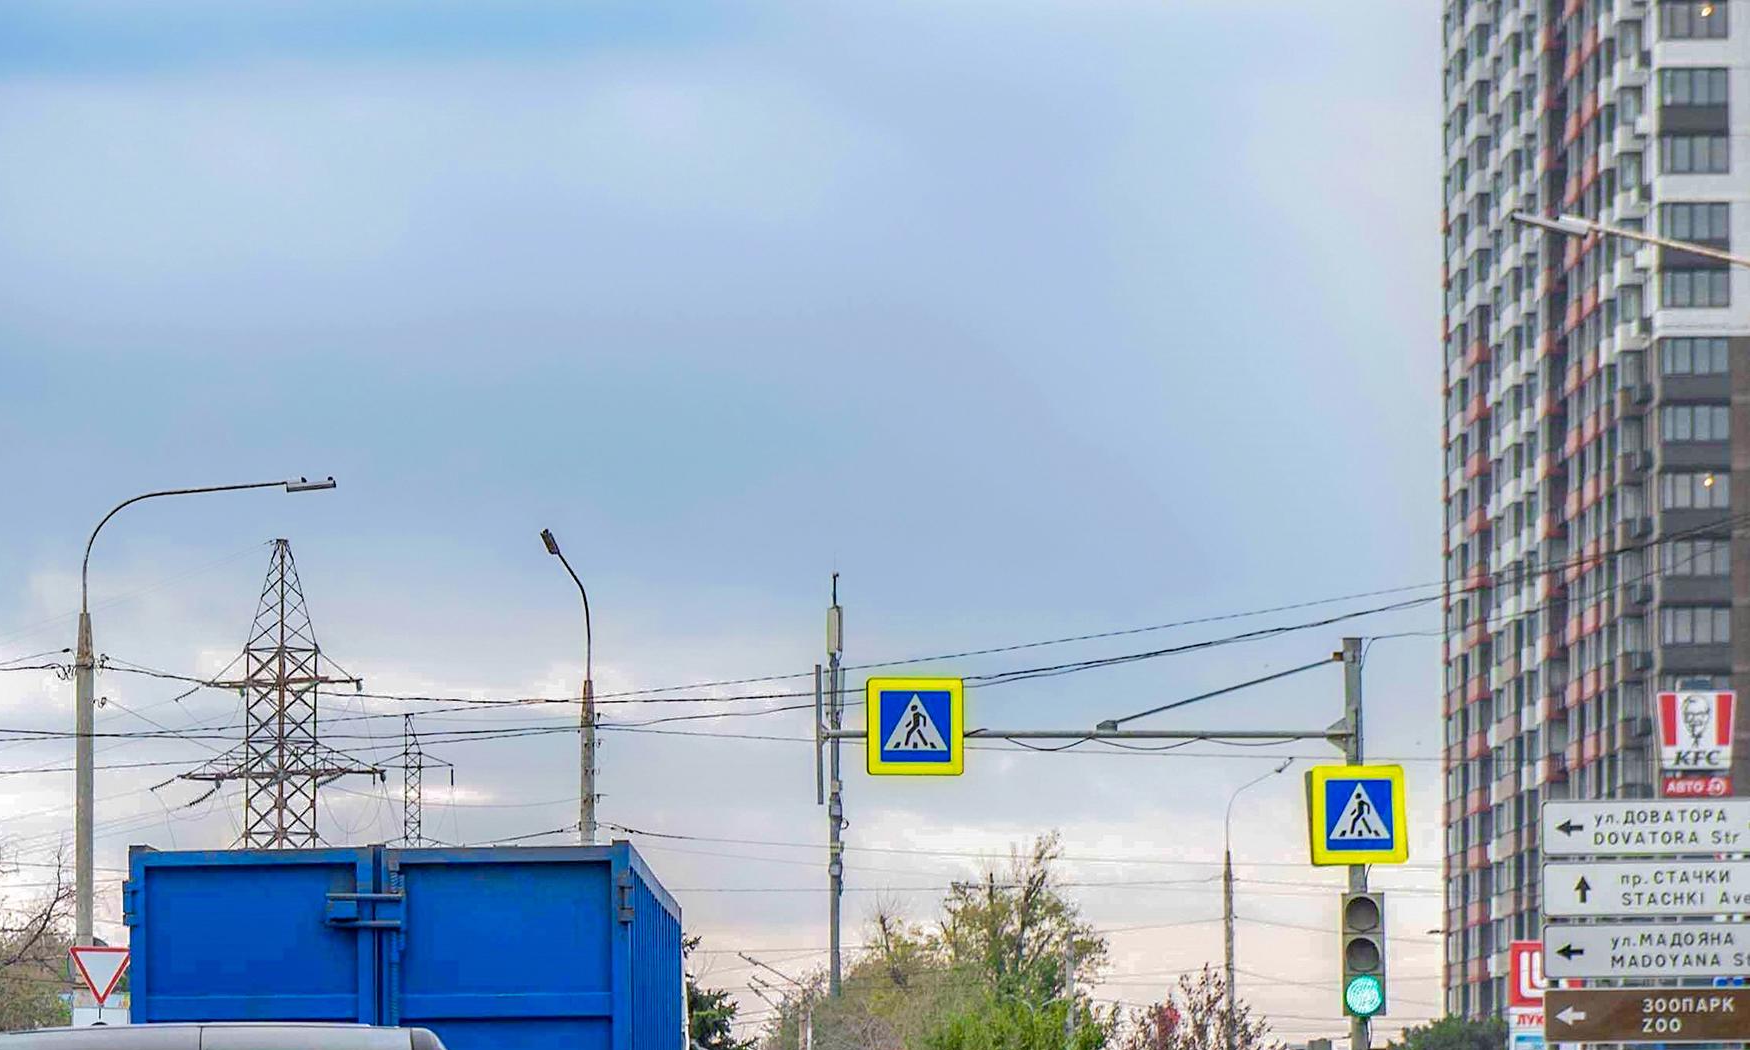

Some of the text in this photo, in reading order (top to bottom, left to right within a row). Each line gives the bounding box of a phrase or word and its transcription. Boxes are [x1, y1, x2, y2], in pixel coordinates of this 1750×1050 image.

[1674, 750, 1721, 766] KFC
[1666, 781, 1703, 793] АВТО
[1594, 830, 1741, 846] DOVATORA Str
[1622, 891, 1750, 906] STACHKI Ave
[1611, 953, 1721, 968] MADOYANA
[1642, 997, 1735, 1013] ЗООПАРК
[1642, 1017, 1682, 1033] ZOO
